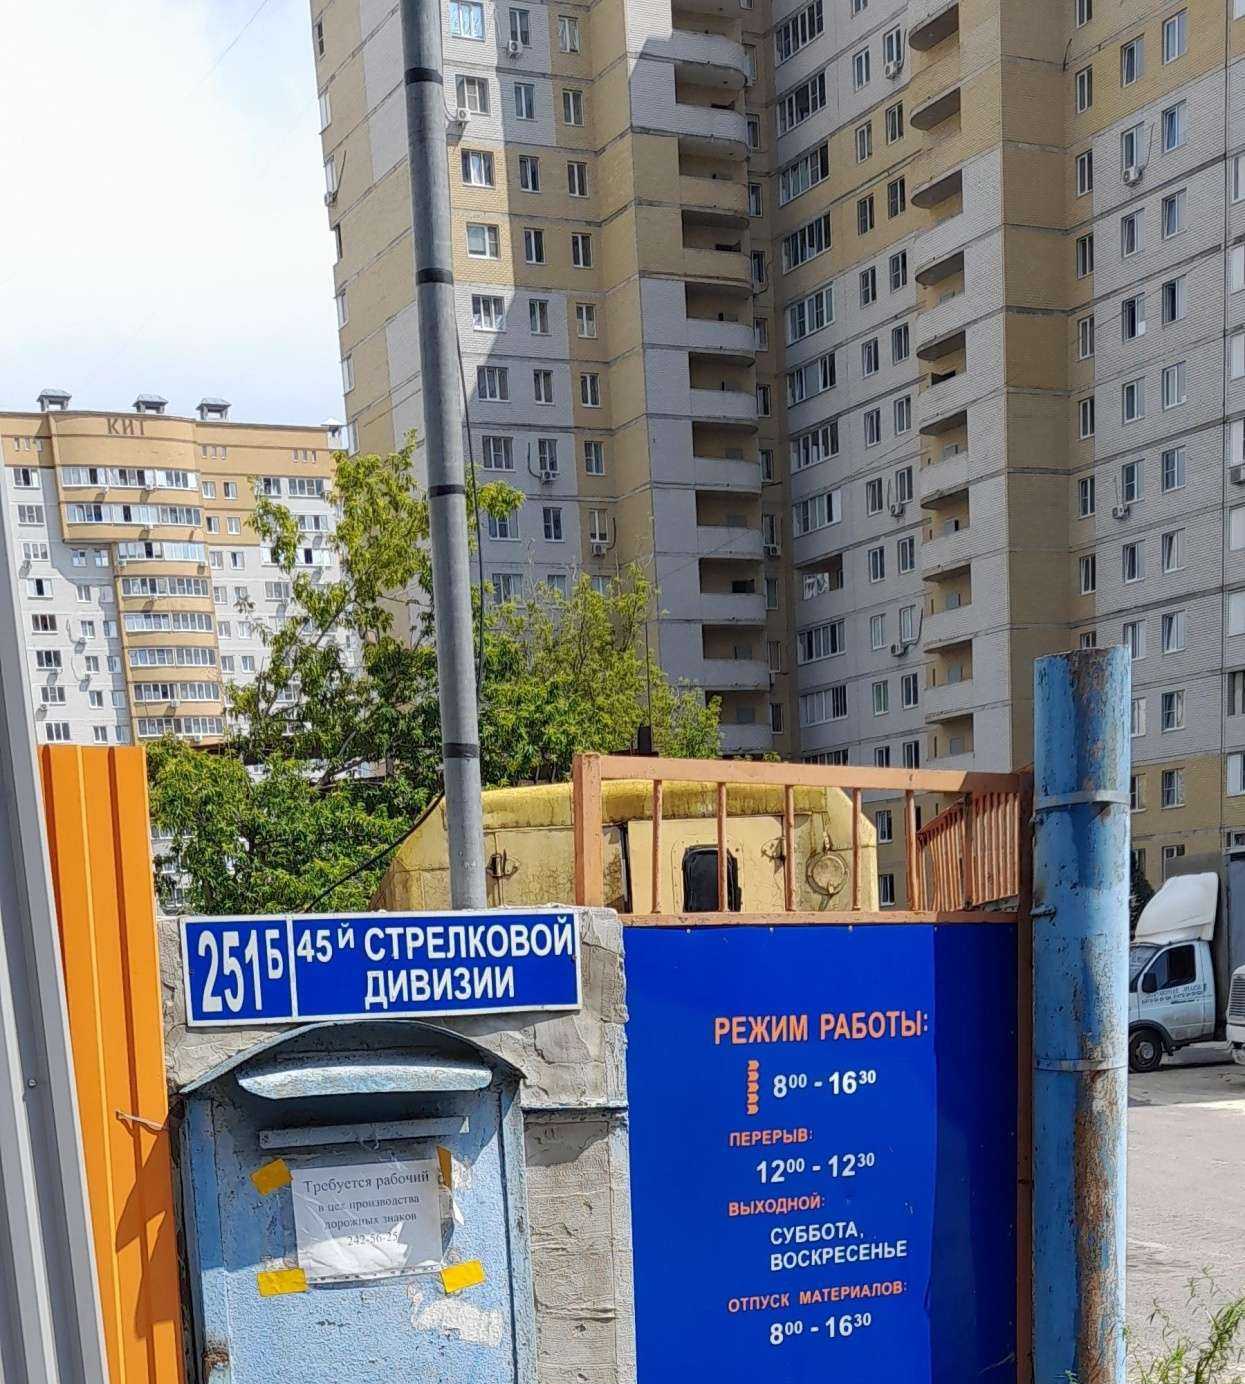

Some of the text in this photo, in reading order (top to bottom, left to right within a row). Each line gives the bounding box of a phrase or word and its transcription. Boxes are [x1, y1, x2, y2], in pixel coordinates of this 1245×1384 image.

[364, 914, 573, 961] СТРЕЛКОВОЙ
[365, 966, 515, 1010] ДИВИЗИИ
[714, 1010, 928, 1045] РЕЖИМ РАБОТЫ:
[729, 1127, 813, 1147] ПЕРЕРЫВ:
[304, 1170, 430, 1195] Требуется рабочий
[349, 1194, 420, 1211] производства
[728, 1192, 825, 1217] ВЫХОДНОЙ:
[383, 1212, 417, 1224] знаков
[770, 1221, 864, 1245] СУББОТА,
[770, 1240, 907, 1271] ВОСКРЕСЕНЬЕ
[728, 1280, 907, 1313] ОТПУСК МАТЕРИАЛОВ:
